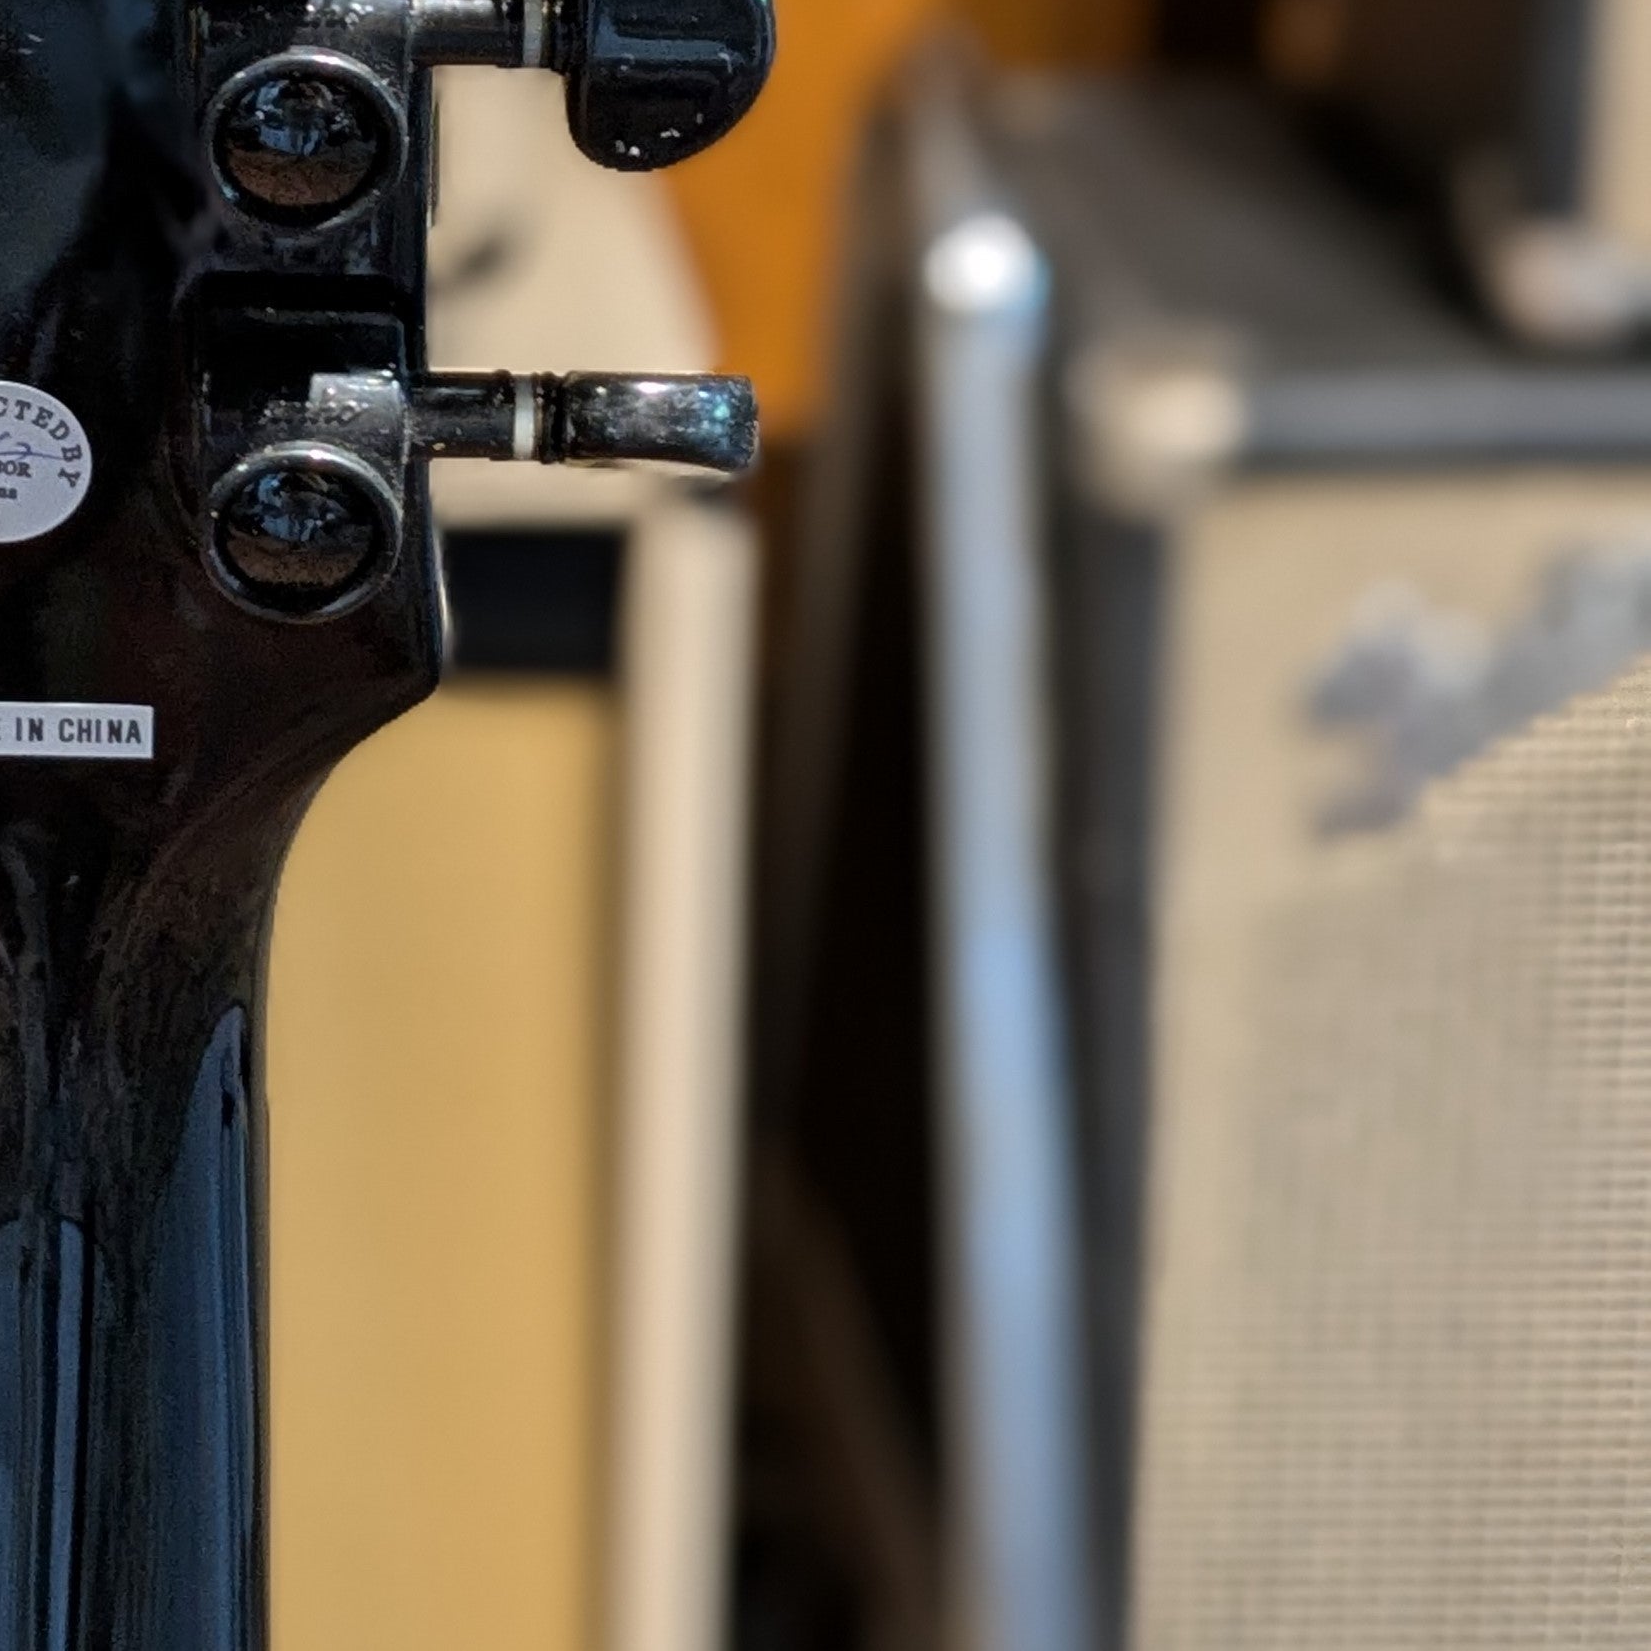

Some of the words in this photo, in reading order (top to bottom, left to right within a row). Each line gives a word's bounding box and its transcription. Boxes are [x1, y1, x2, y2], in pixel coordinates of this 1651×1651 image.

[58, 444, 83, 488] BY
[16, 717, 44, 742] IN
[58, 718, 142, 744] CHINA
